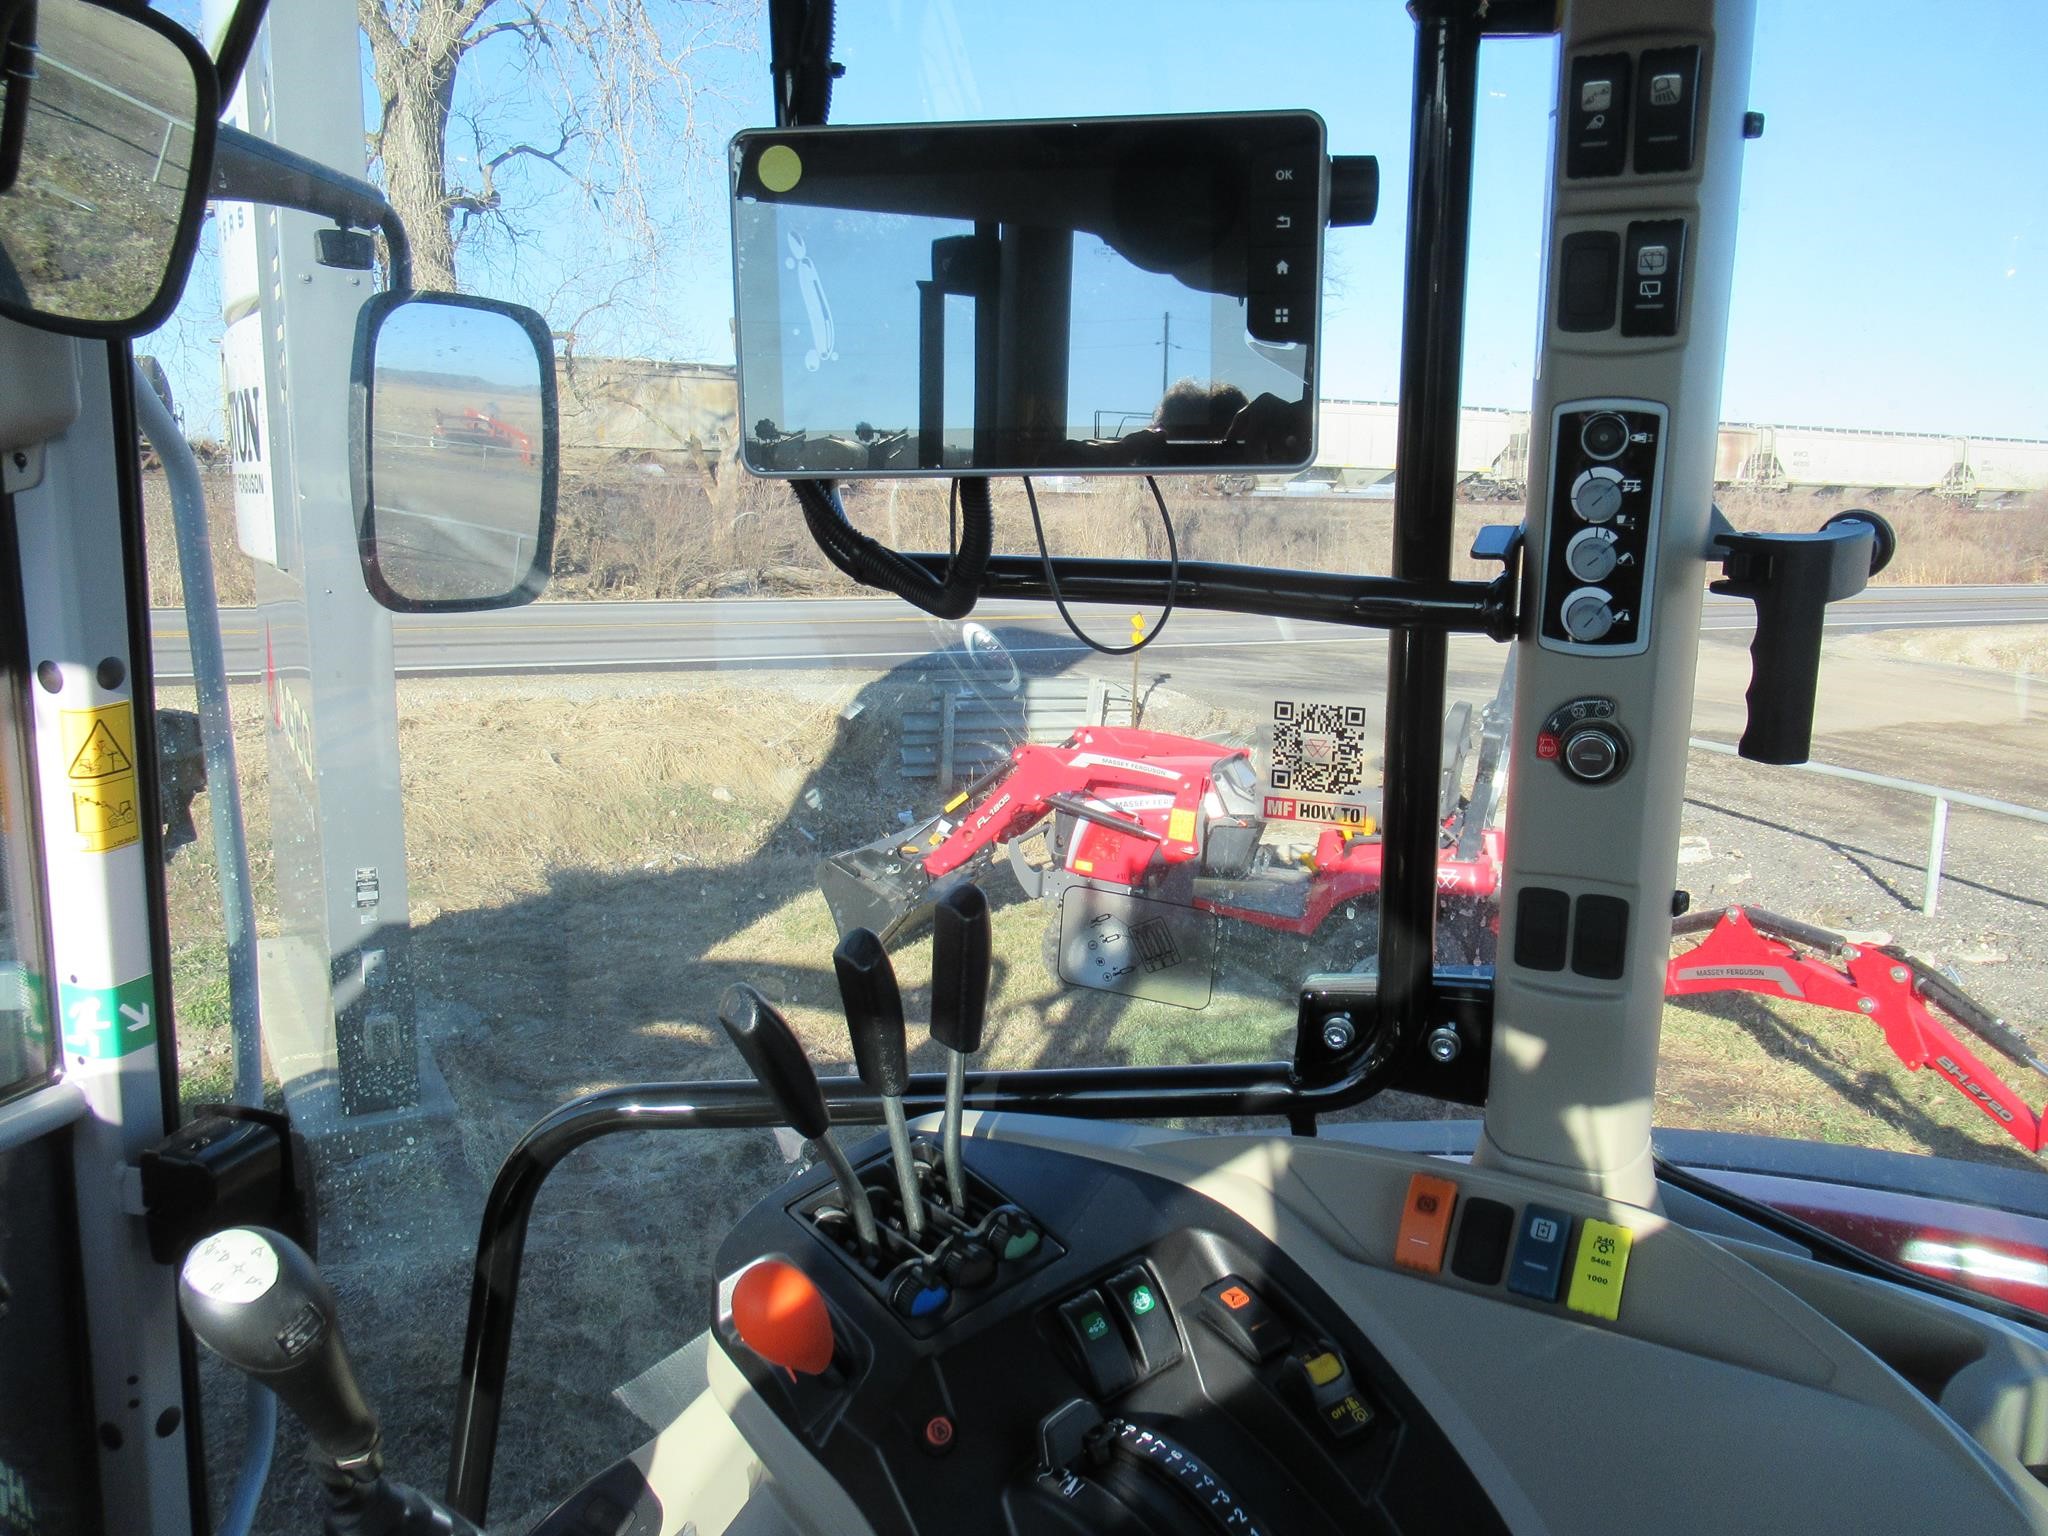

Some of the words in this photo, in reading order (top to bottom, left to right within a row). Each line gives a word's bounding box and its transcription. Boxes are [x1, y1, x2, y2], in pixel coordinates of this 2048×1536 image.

[1275, 169, 1294, 181] OK
[1102, 757, 1129, 768] MASSEY
[1131, 762, 1167, 776] FERGUSON
[1115, 801, 1149, 810] MASSEY
[1266, 799, 1294, 817] MF
[1299, 802, 1338, 822] HOW
[1340, 806, 1361, 824] TO
[1696, 967, 1725, 977] MASSEY
[1726, 967, 1765, 977] FERGUSON
[1591, 1256, 1612, 1267] 540E
[1586, 1273, 1609, 1286] 1000
[1330, 1404, 1346, 1419] OFF
[1154, 1438, 1167, 1449] 7
[1185, 1460, 1199, 1474] 5
[1202, 1474, 1215, 1488] 4
[1217, 1489, 1231, 1504] 3
[1233, 1507, 1248, 1524] 2
